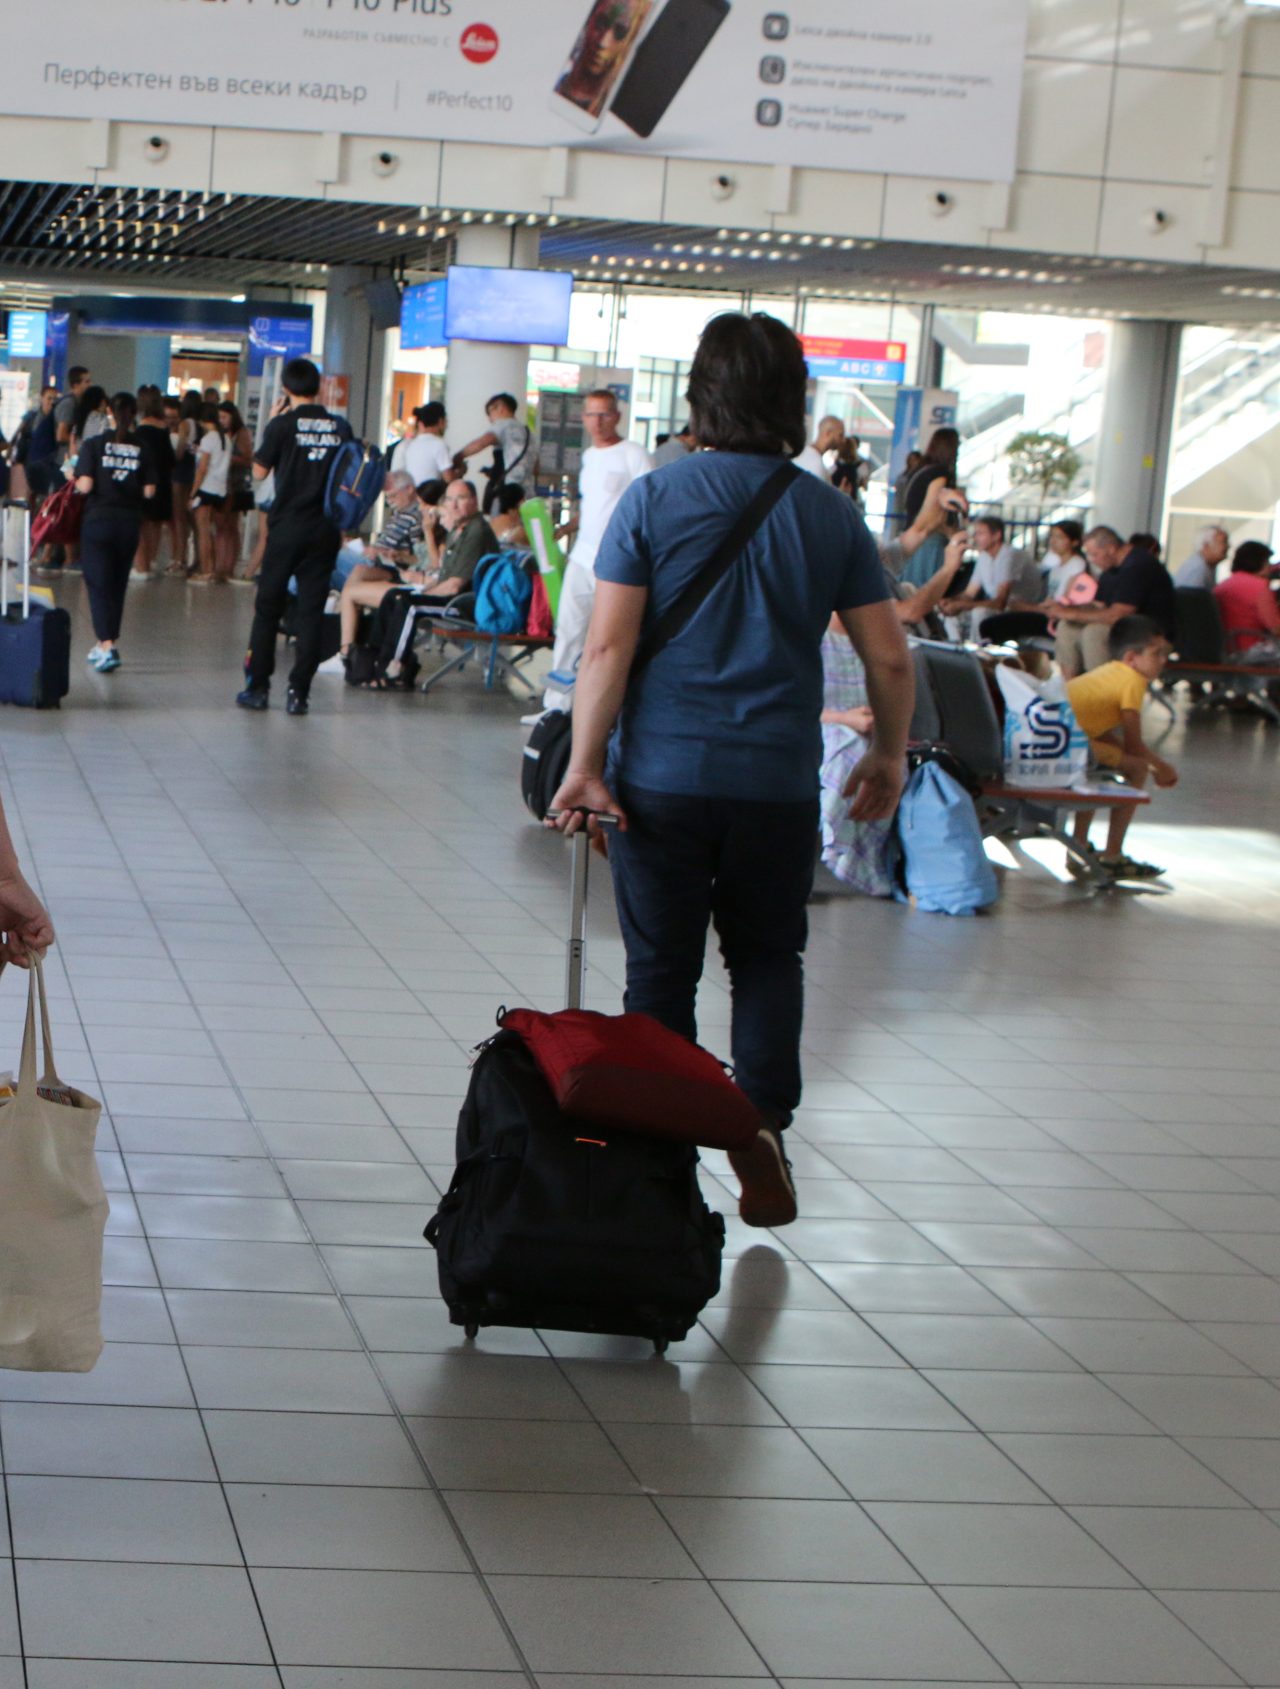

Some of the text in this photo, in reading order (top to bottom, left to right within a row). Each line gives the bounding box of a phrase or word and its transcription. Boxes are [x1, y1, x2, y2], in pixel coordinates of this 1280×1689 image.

[43, 62, 514, 112] Перфектен във всеки кадър #Perfect10
